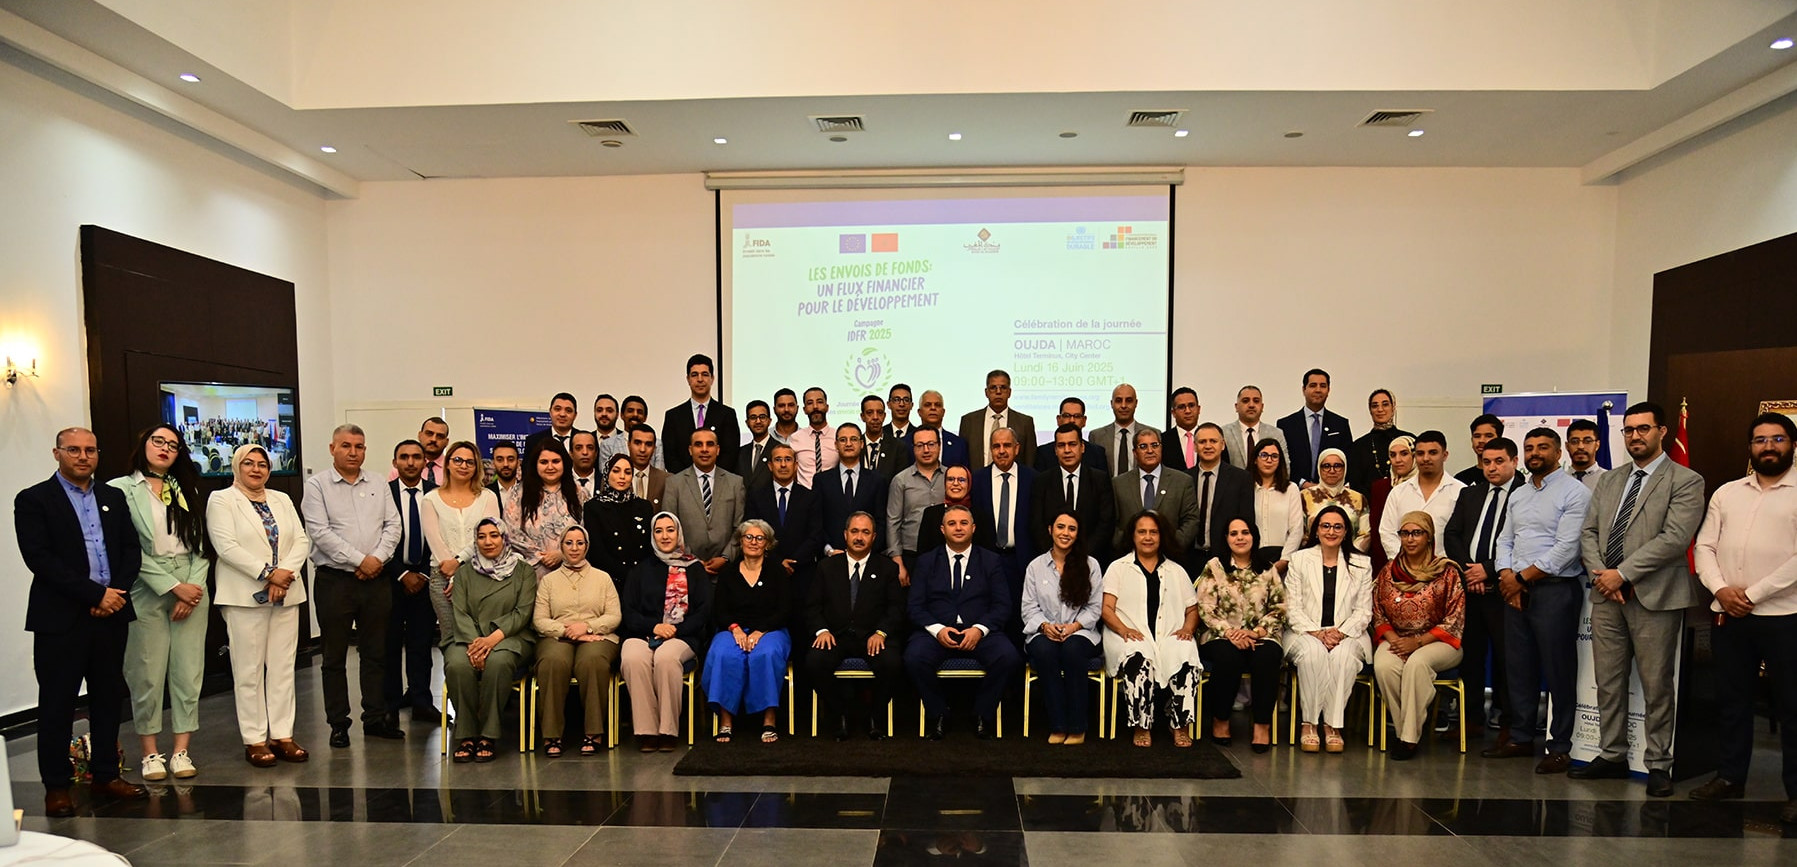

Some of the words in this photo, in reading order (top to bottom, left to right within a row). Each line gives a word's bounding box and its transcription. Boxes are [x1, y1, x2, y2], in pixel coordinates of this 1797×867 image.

[808, 267, 827, 282] LES
[830, 263, 872, 280] ENVOIS
[876, 262, 888, 276] DE
[892, 260, 933, 275] FONDS:
[817, 284, 833, 297] UN
[837, 280, 863, 296] FLUX
[867, 277, 925, 294] FINANCIER
[798, 300, 829, 316] POUR
[833, 299, 843, 313] LE
[847, 293, 939, 312] DÉVELOPPEMENT
[854, 320, 883, 328] Campagne
[1014, 320, 1072, 329] Célébration
[1076, 320, 1088, 328] de
[1092, 320, 1100, 328] la
[1103, 320, 1142, 330] journée
[847, 330, 866, 342] IDFR
[869, 328, 891, 340] 2025
[1014, 340, 1056, 350] OUJDA
[1066, 339, 1111, 350] MAROC
[1014, 362, 1043, 372] Lundi
[1048, 362, 1058, 372] 16
[1062, 362, 1083, 372] Juin
[1087, 362, 1113, 372] 2025
[1582, 714, 1601, 722] OUJD
